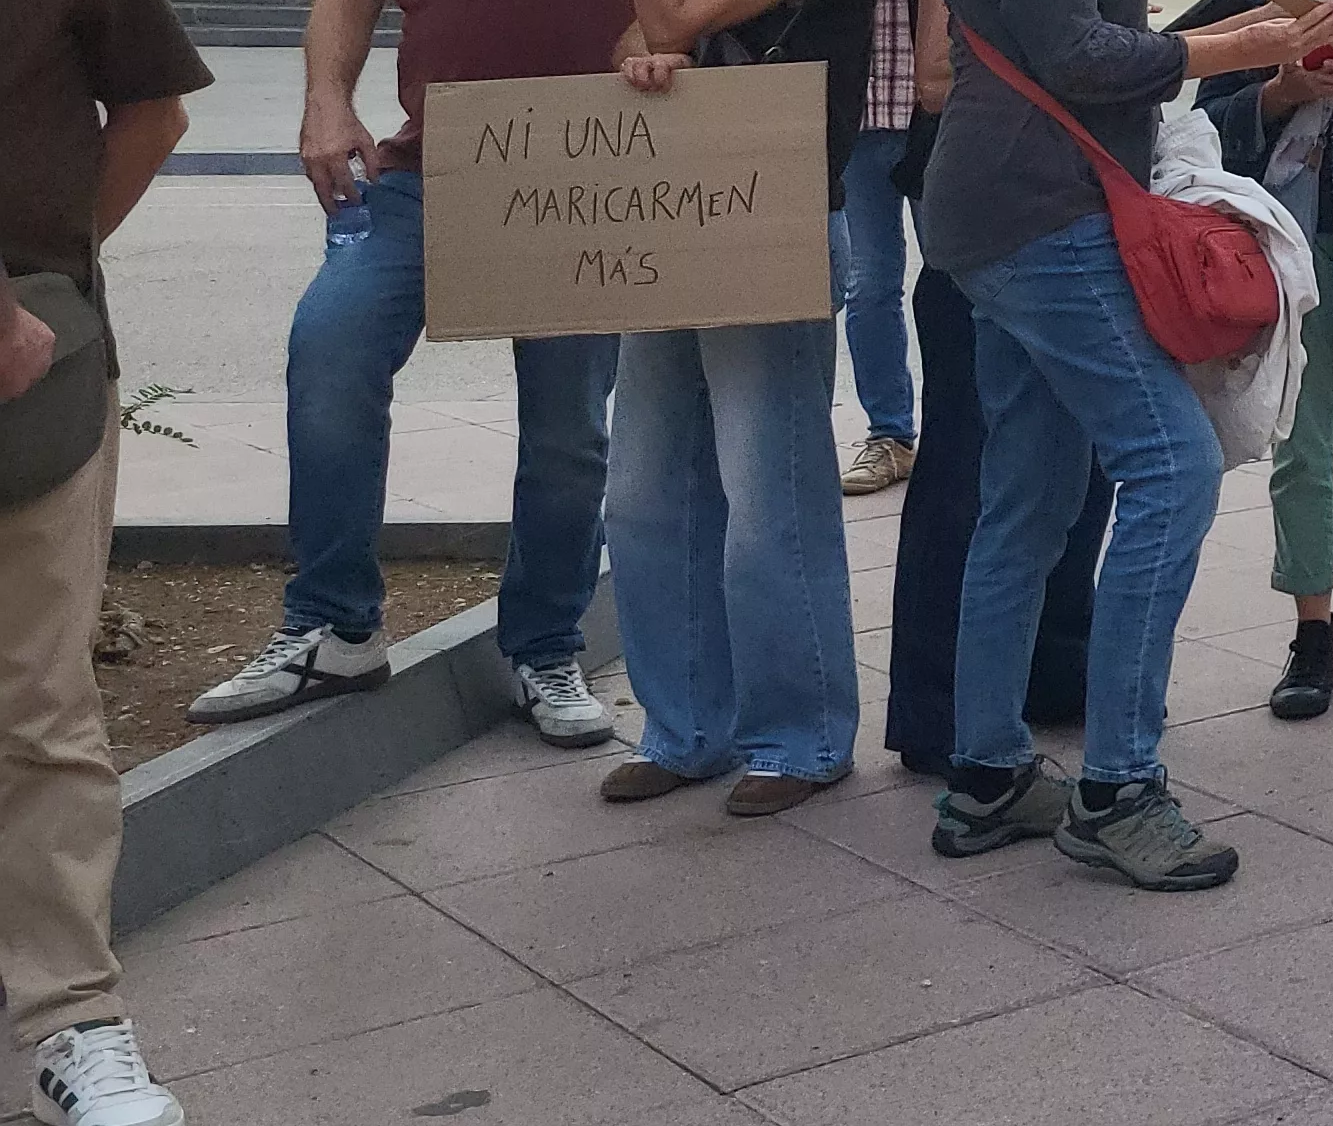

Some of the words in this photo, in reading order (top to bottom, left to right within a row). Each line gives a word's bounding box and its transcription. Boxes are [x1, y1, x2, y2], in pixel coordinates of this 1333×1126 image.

[475, 106, 534, 164] NI
[564, 110, 656, 160] UNA
[502, 170, 760, 228] MARICARMEN
[573, 245, 660, 288] MÁS
